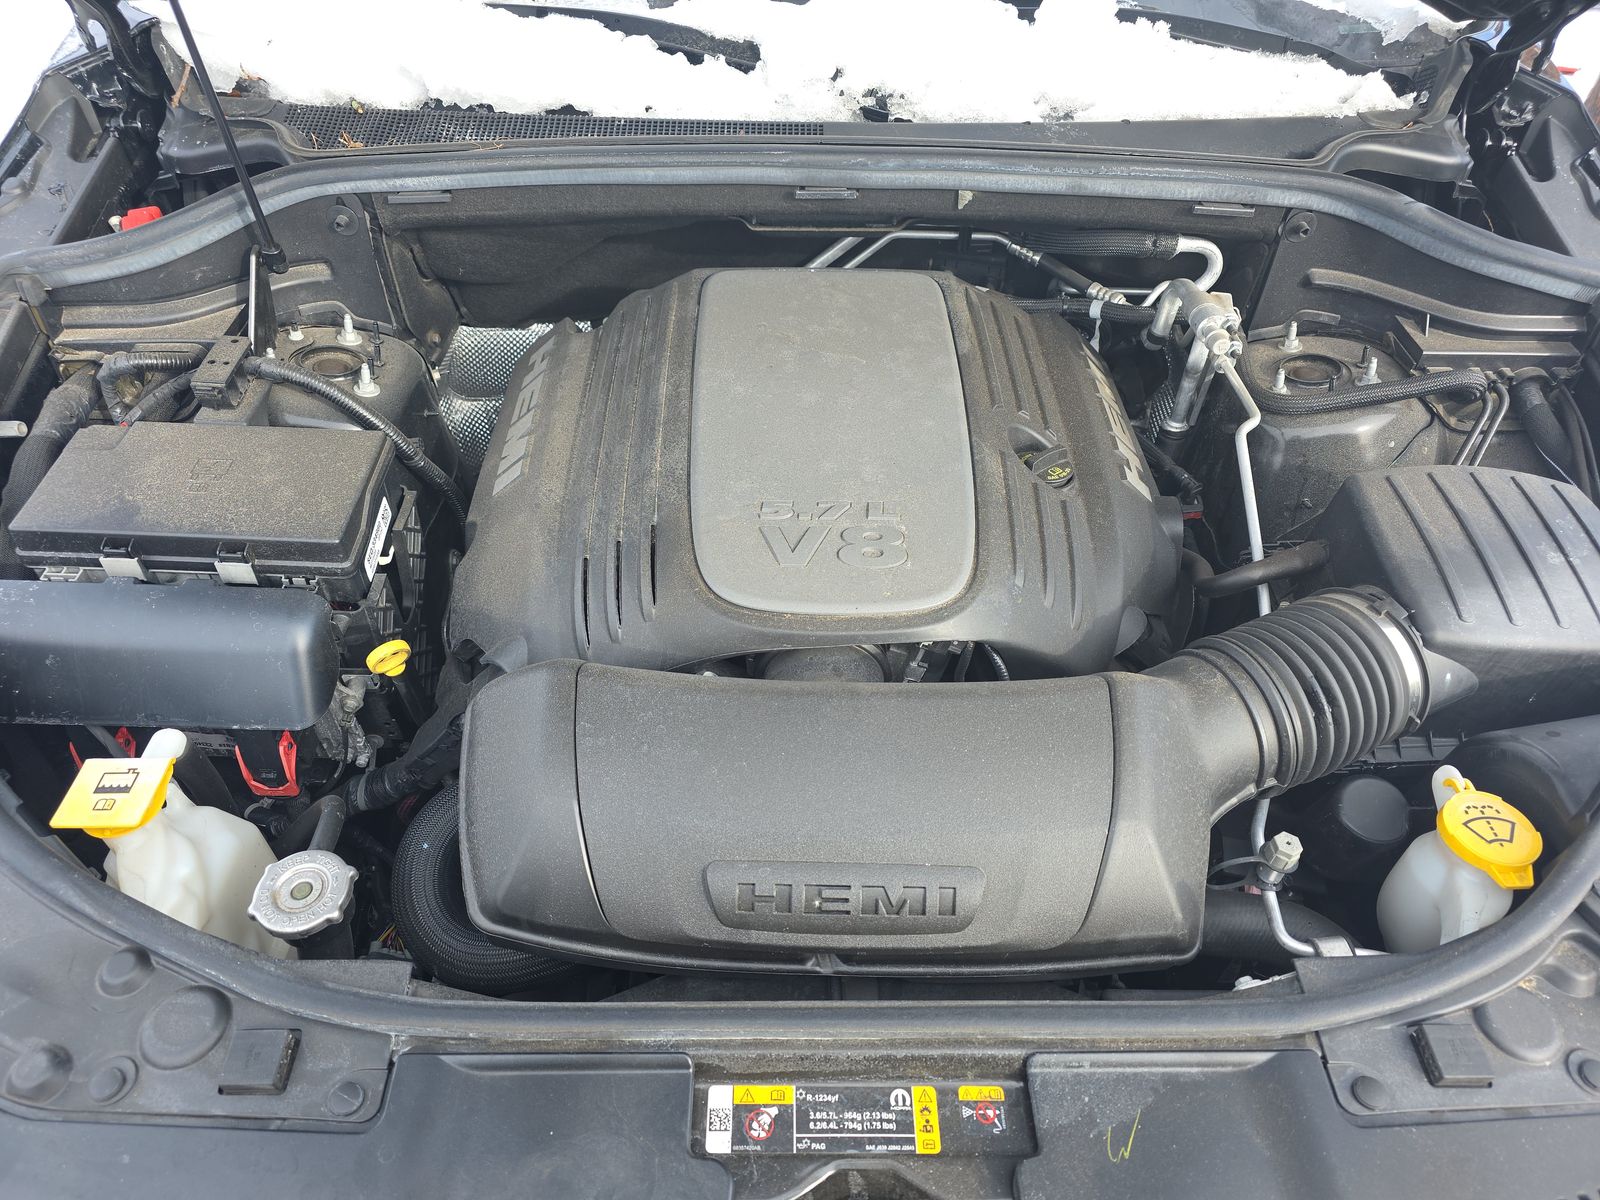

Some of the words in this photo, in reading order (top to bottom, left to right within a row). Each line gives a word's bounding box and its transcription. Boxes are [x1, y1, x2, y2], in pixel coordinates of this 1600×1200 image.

[492, 334, 556, 496] HEMI
[758, 525, 909, 570] V8
[279, 854, 310, 873] KEEP
[736, 882, 957, 917] HEMI
[806, 1093, 839, 1103] R-1234yf
[809, 1111, 838, 1120] 3.6/5.7L
[863, 1111, 881, 1120] (2.13
[882, 1111, 896, 1120] lbs)
[809, 1121, 838, 1130] 6.2/6.4L
[844, 1121, 862, 1131] 794g
[863, 1121, 881, 1131] (1.75
[882, 1121, 896, 1131] lbs)
[811, 1142, 826, 1150] PAG
